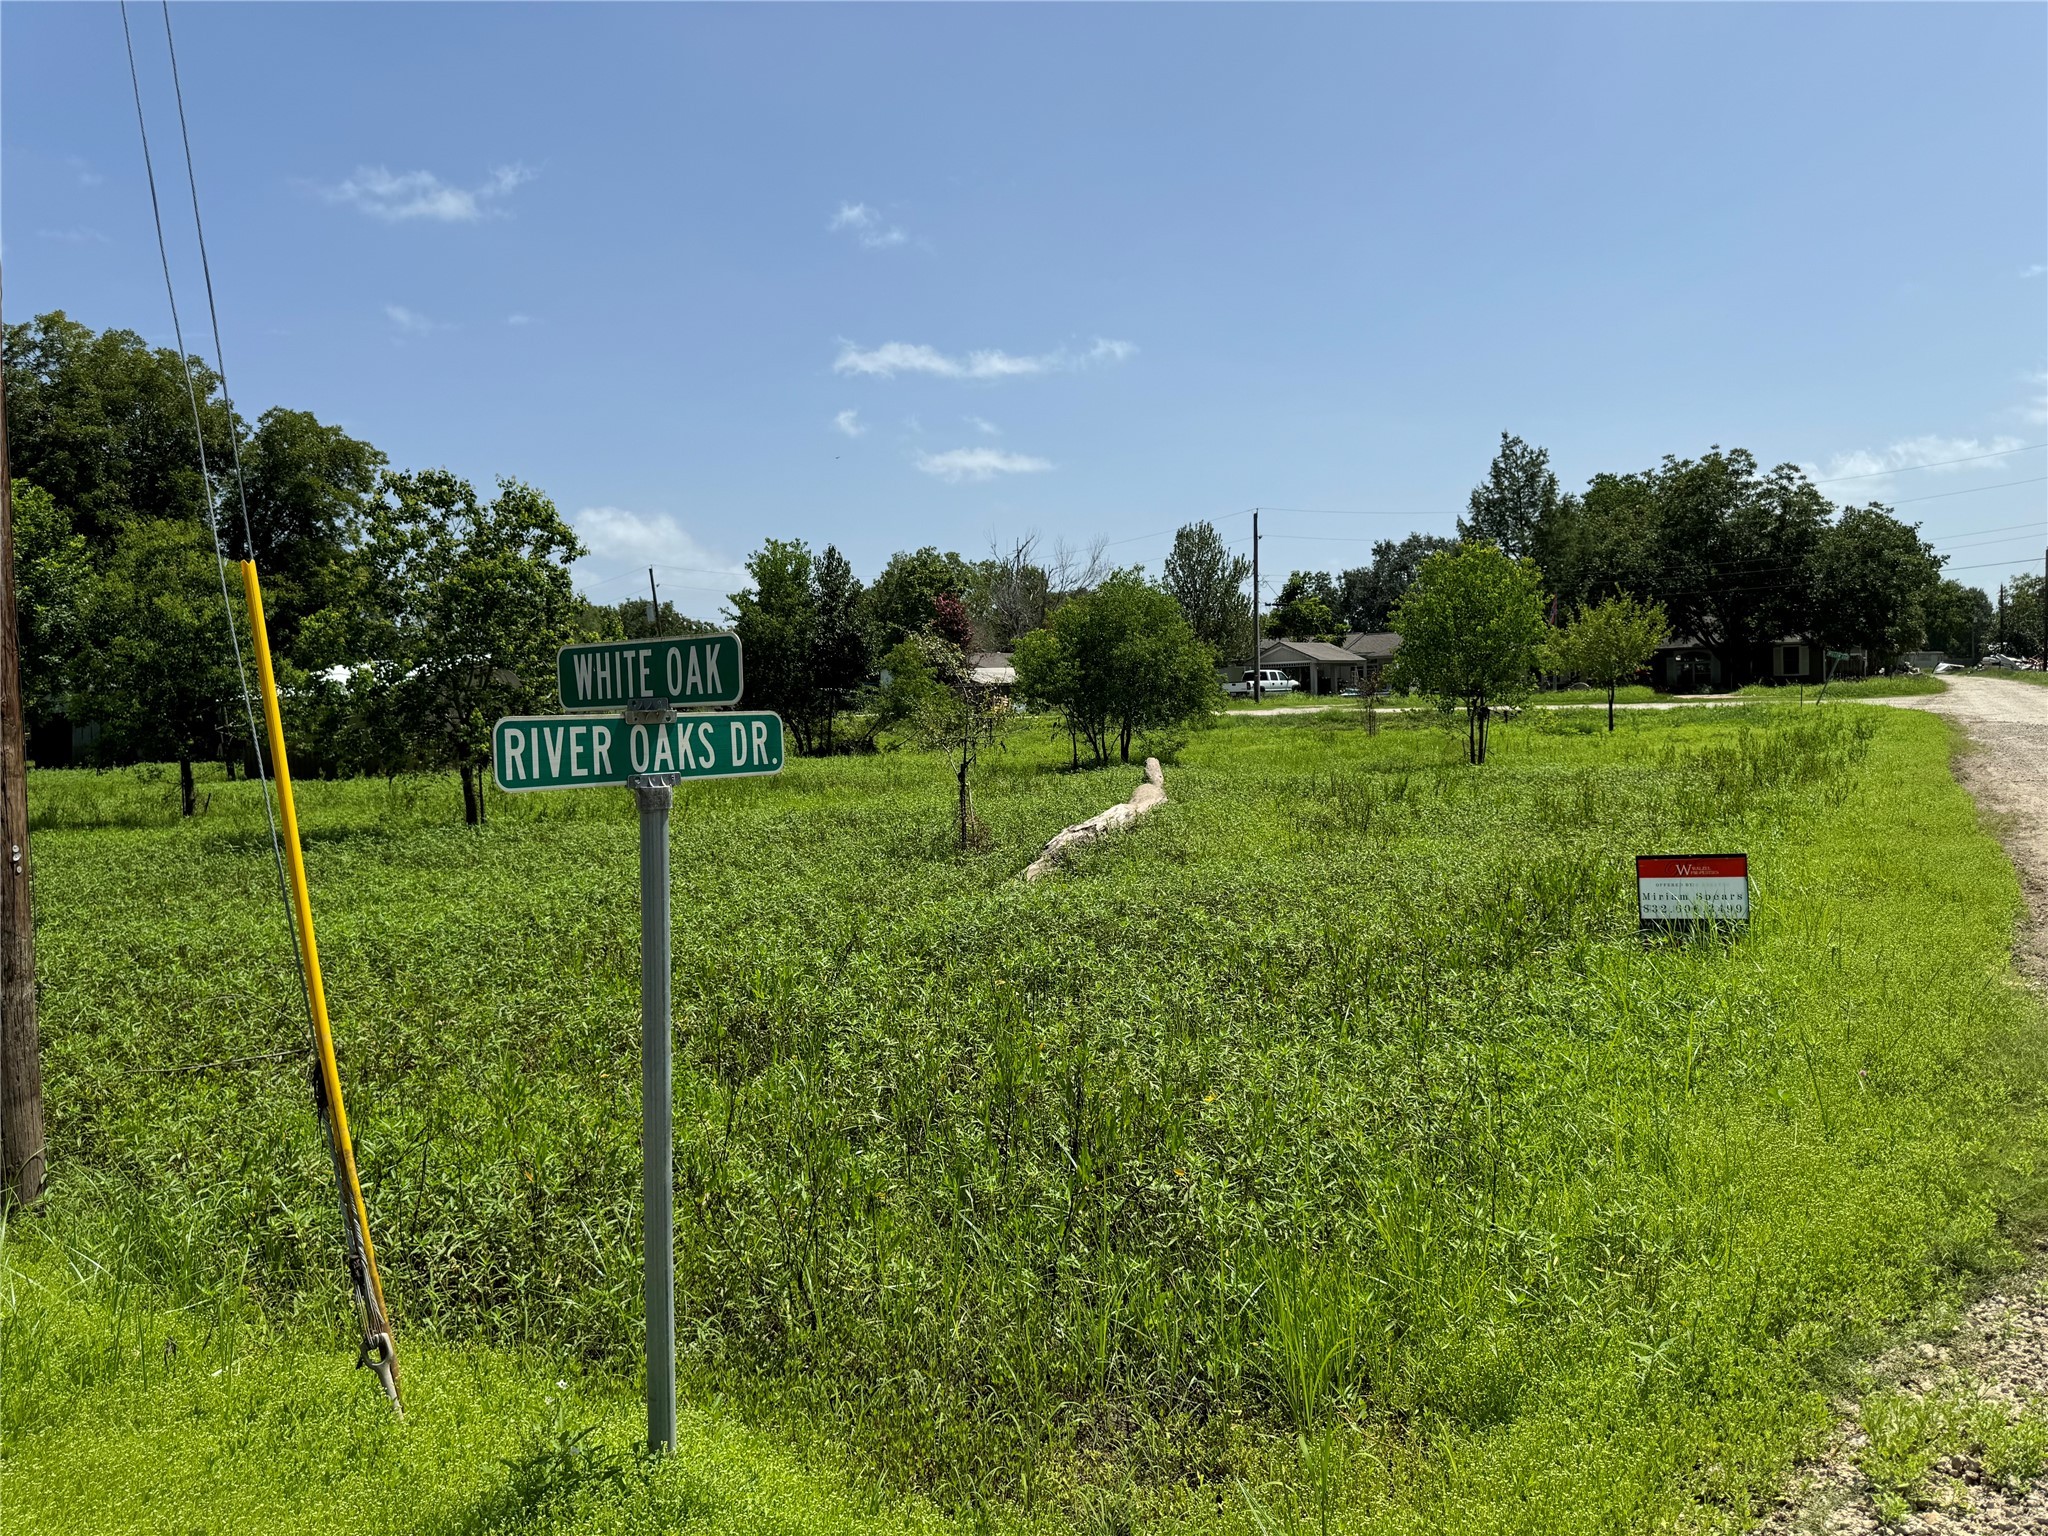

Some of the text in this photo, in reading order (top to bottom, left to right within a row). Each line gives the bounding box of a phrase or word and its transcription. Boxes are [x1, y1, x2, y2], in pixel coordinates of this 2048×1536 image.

[573, 643, 723, 701] WHITE OAK
[504, 720, 779, 781] RIVER OAKS DR.
[1642, 892, 1743, 901] Miriam Spears
